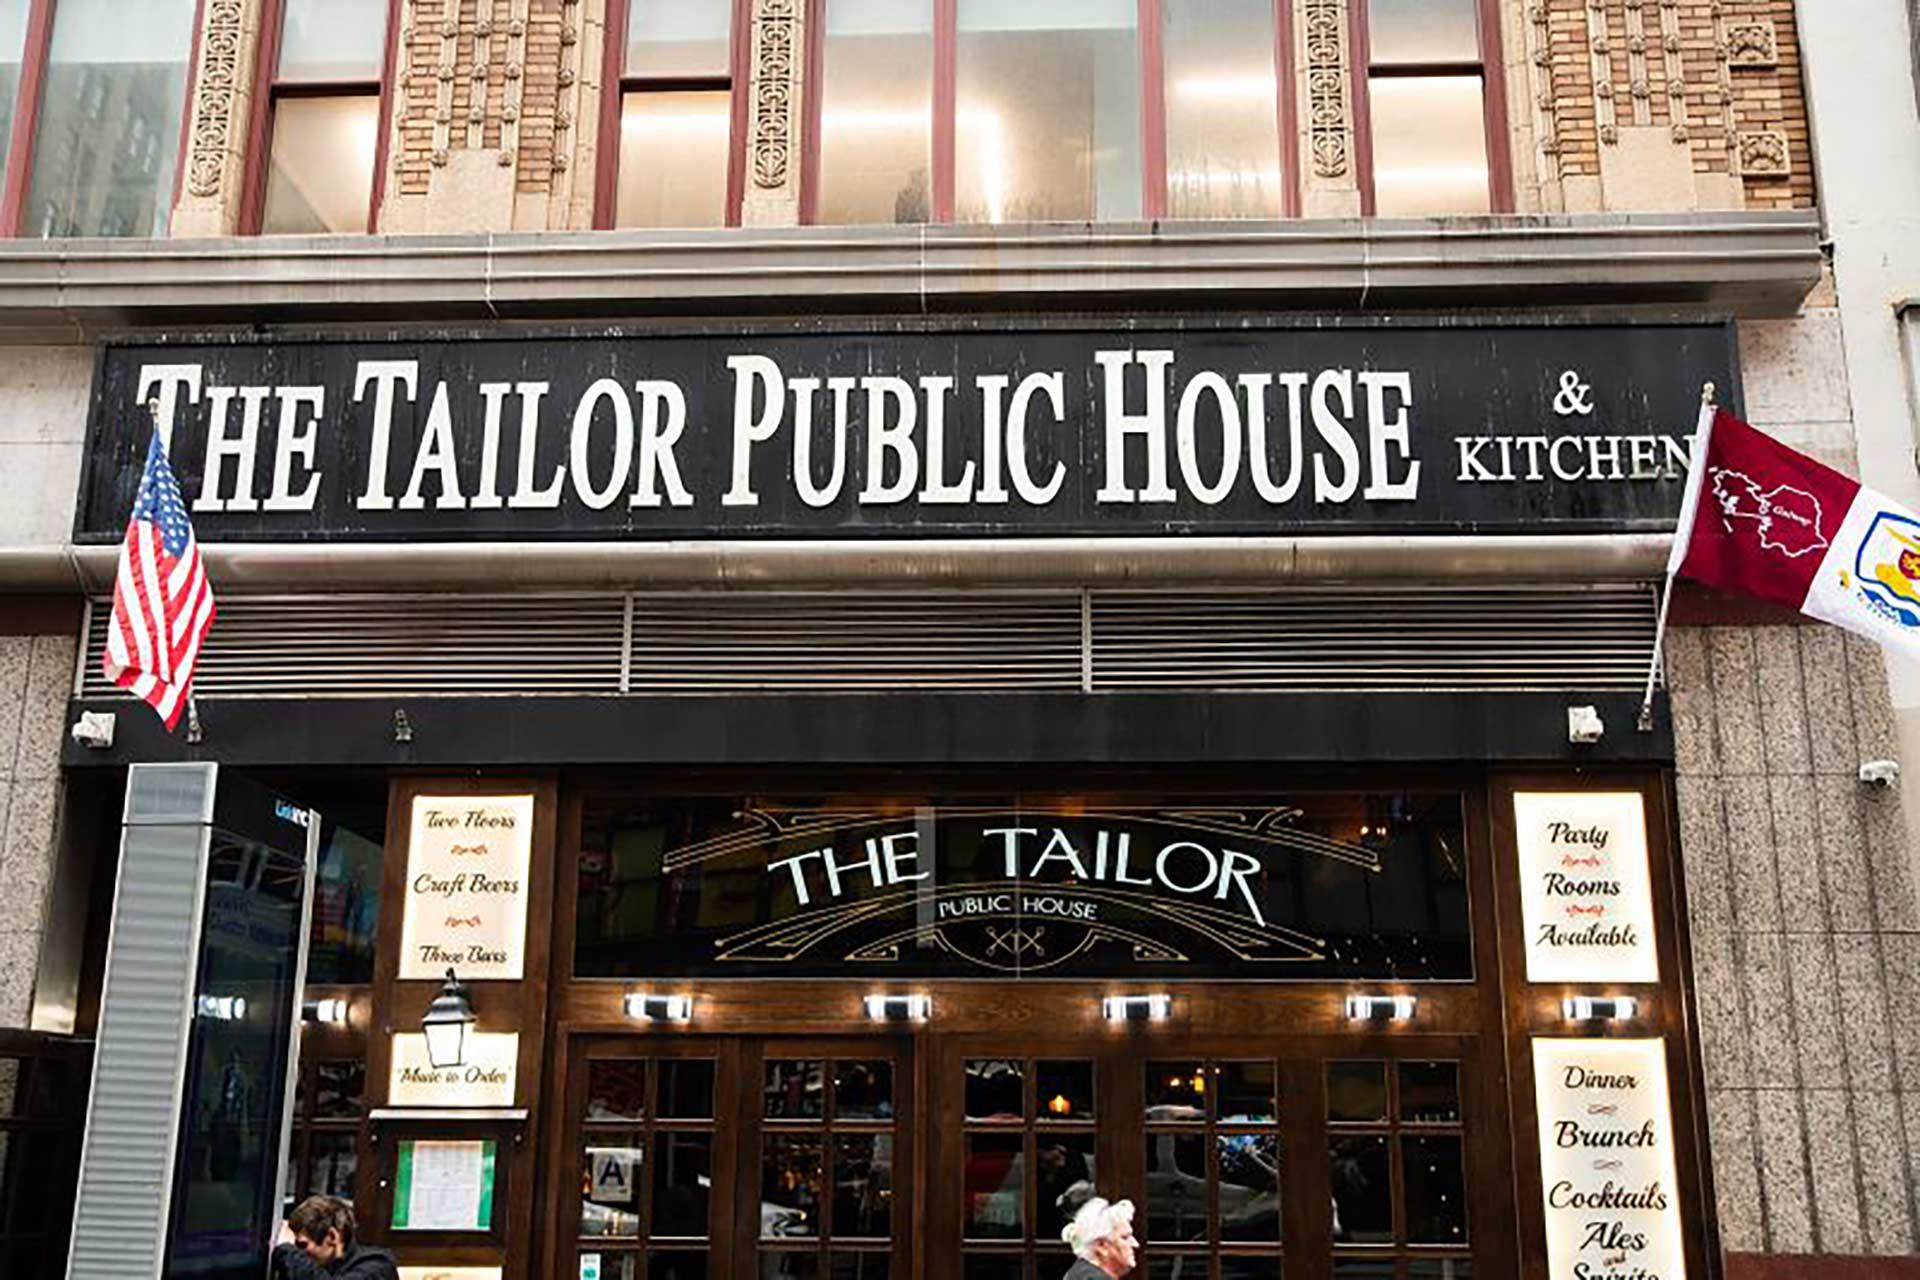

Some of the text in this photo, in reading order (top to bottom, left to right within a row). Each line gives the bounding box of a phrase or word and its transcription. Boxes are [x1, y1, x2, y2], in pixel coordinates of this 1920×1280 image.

[1553, 370, 1594, 415] &
[136, 350, 1420, 511] THE TAILOR PUBLIC HOUSE
[1454, 435, 1696, 481] KITCHEN
[1547, 821, 1610, 851] Party
[413, 873, 519, 898] Craft Beers
[767, 828, 1266, 928] THE TAILOR
[1542, 871, 1622, 896] Rooms
[938, 894, 1099, 920] PUBLIC HOUSE
[1536, 922, 1638, 947] Available
[1562, 1065, 1640, 1089] Dinner
[1554, 1119, 1656, 1149] Brunch
[598, 1158, 625, 1187] A
[1549, 1180, 1668, 1211] Cocktails
[1579, 1221, 1649, 1251] Ales
